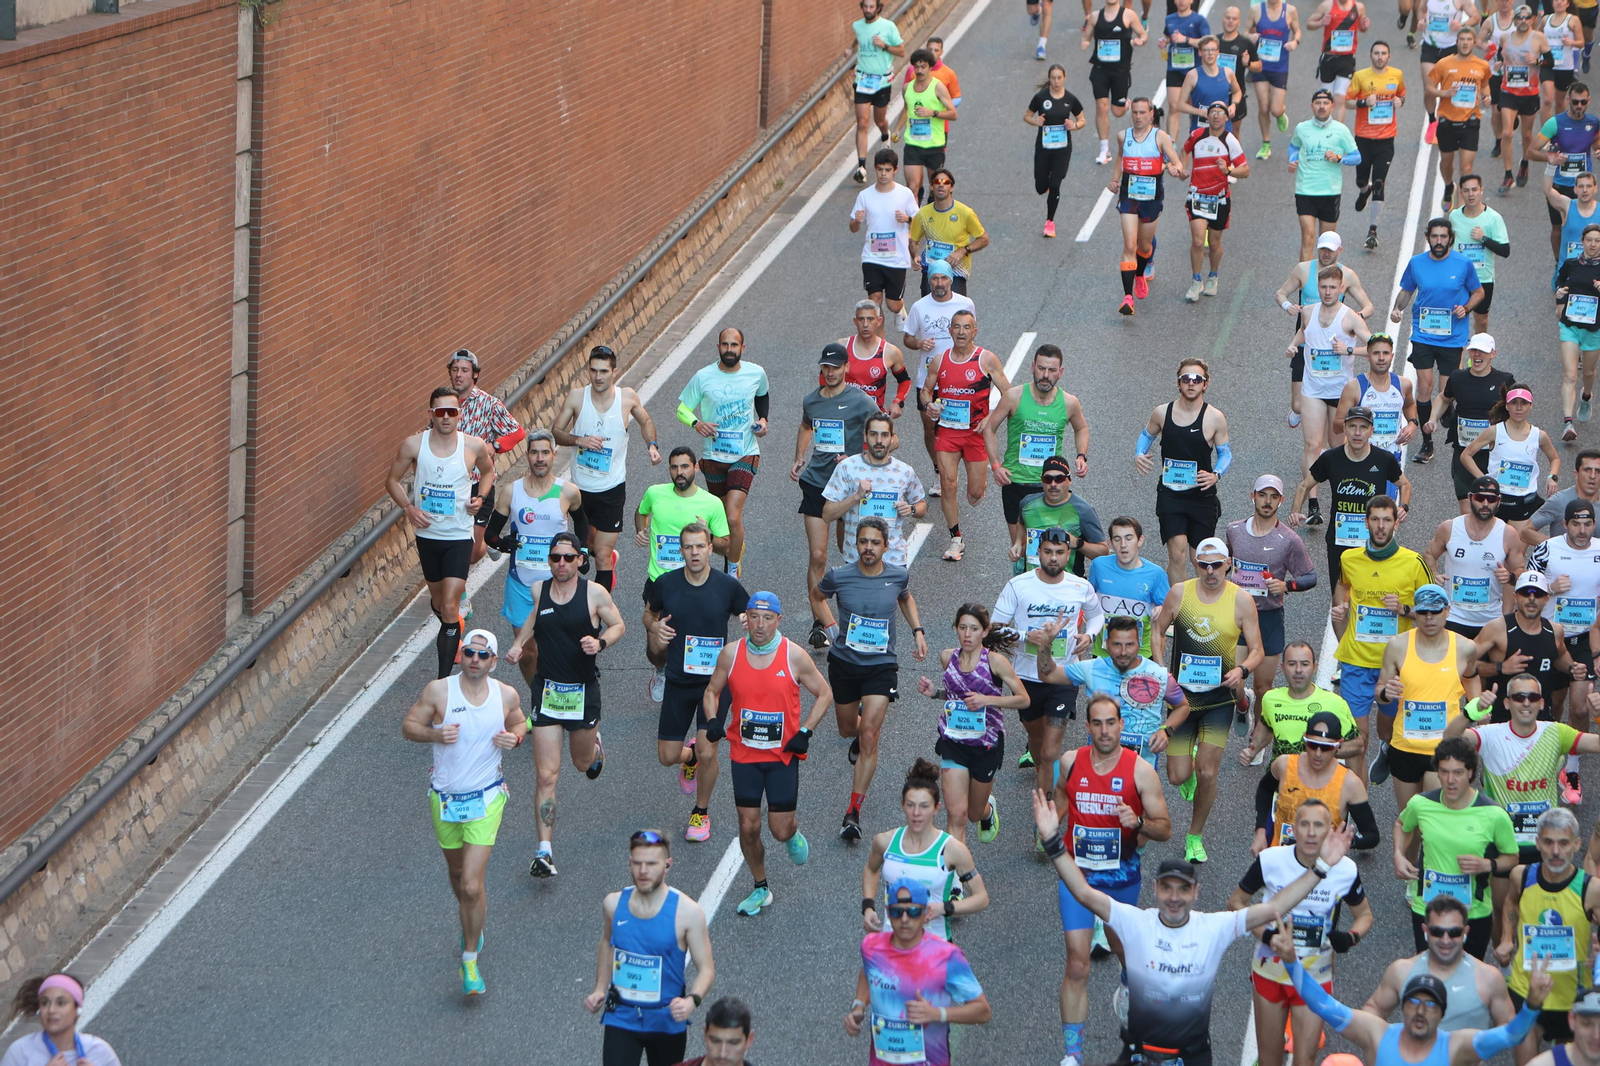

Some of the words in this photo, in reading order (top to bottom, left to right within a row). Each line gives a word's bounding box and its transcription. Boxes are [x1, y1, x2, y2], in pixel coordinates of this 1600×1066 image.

[846, 381, 877, 392] ARINOCIO
[942, 386, 975, 395] MARINOCIO
[1337, 501, 1366, 513] SEVILL
[540, 607, 555, 616] HOKA
[864, 620, 886, 628] ZURICH
[754, 714, 778, 722] ZURICH
[1274, 713, 1311, 723] DEPORTEMA
[455, 792, 479, 801] ZURICH
[1076, 792, 1090, 802] CLUB
[1088, 830, 1114, 838] ZURICH
[1087, 844, 1106, 853] 11325
[1293, 916, 1320, 924] ZURICH
[627, 956, 654, 968] ZURICH
